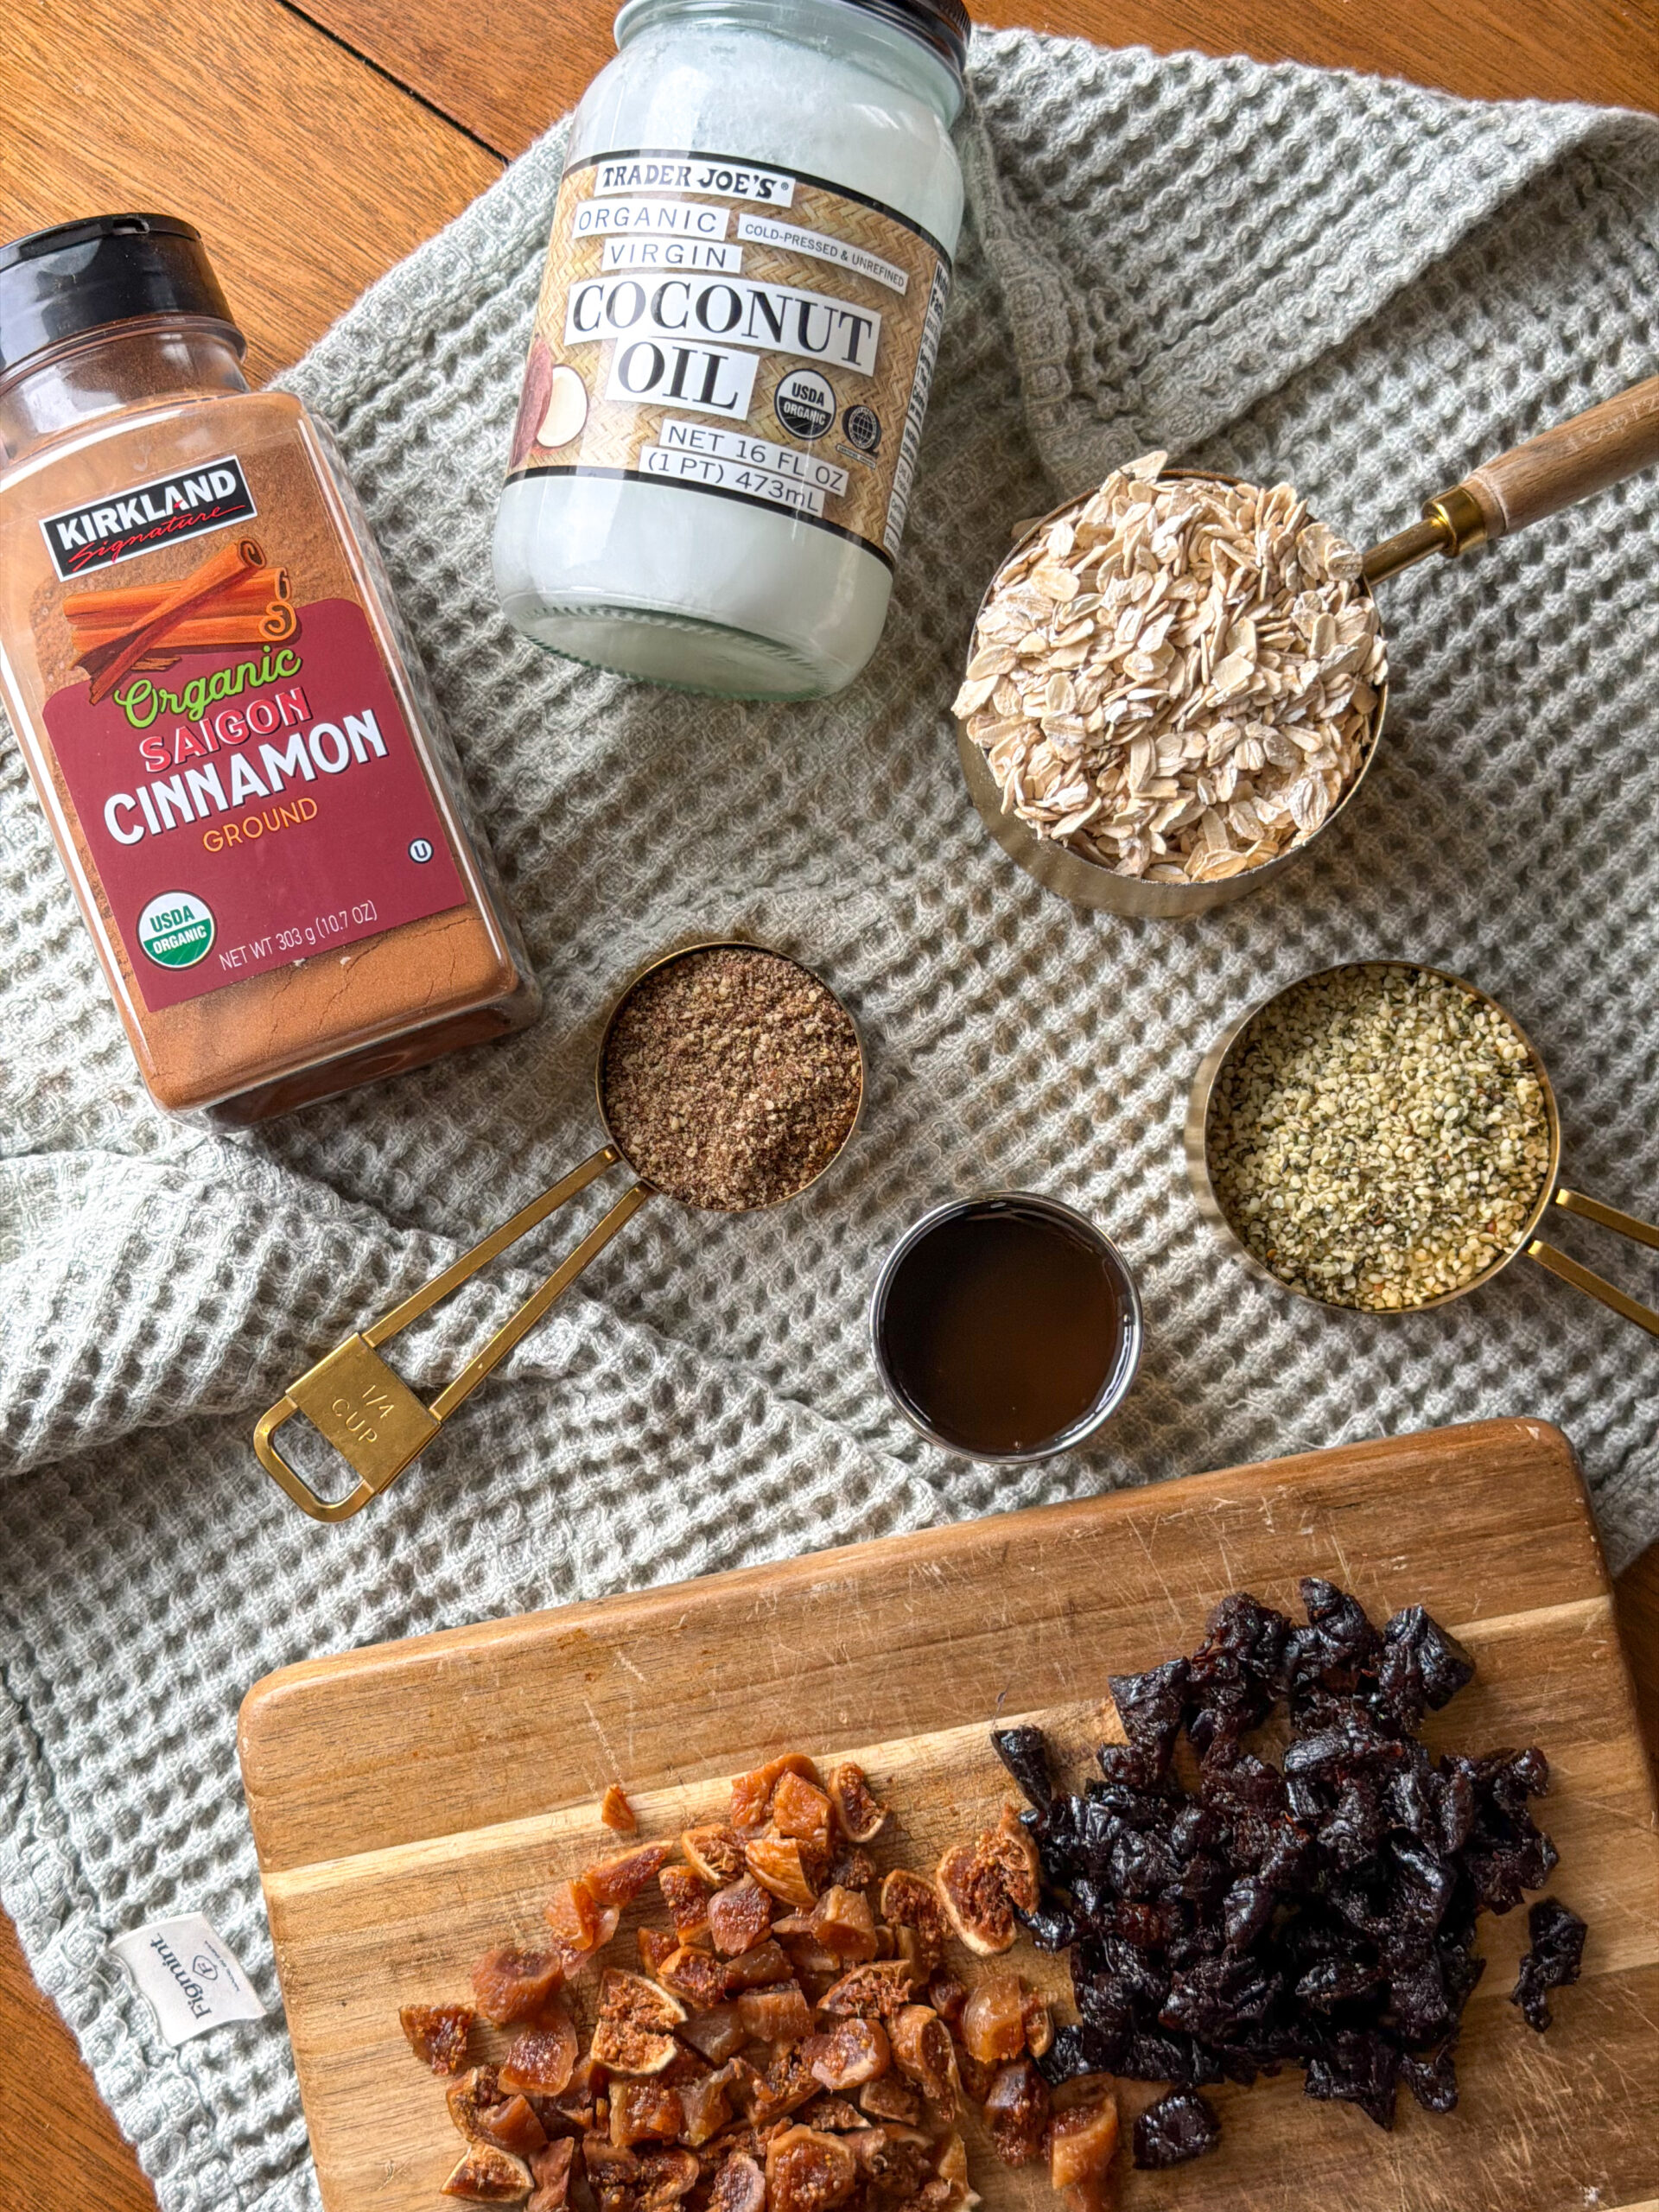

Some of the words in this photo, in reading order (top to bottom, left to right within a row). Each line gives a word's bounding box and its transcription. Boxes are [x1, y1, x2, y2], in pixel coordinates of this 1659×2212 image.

[602, 164, 691, 188] TRADER
[578, 207, 717, 233] ORGANIC
[610, 244, 727, 269] VIRGIN
[745, 223, 838, 257] COLD-PRESSED
[840, 250, 849, 262] &
[851, 253, 905, 288] UNREFINED
[573, 281, 874, 366] COCONUT
[618, 341, 739, 410] OIL
[791, 382, 825, 407] USDA
[783, 401, 826, 426] ORGANIC
[648, 452, 670, 472] (1
[680, 457, 724, 484] PT)
[735, 472, 819, 512] 473mL
[667, 425, 725, 452] NET
[735, 440, 766, 463] 16
[777, 451, 805, 477] FL
[815, 466, 845, 492] OZ
[56, 469, 237, 551] KIRKLAND
[67, 500, 246, 572] Signature
[113, 645, 302, 728] Organic
[139, 687, 313, 772] SAIGON
[104, 709, 390, 845] CINNAMON
[202, 798, 318, 853] GROUND
[149, 905, 195, 933] USDA
[153, 925, 207, 956] ORGANIC
[219, 944, 248, 971] NET
[249, 937, 273, 961] WT
[275, 927, 303, 950] 303
[305, 927, 316, 945] g
[315, 910, 348, 939] (10.7
[352, 899, 378, 924] OZ)
[332, 1398, 378, 1443] CUP
[362, 1384, 395, 1420] 1/4
[149, 1932, 213, 2020] Figmint
